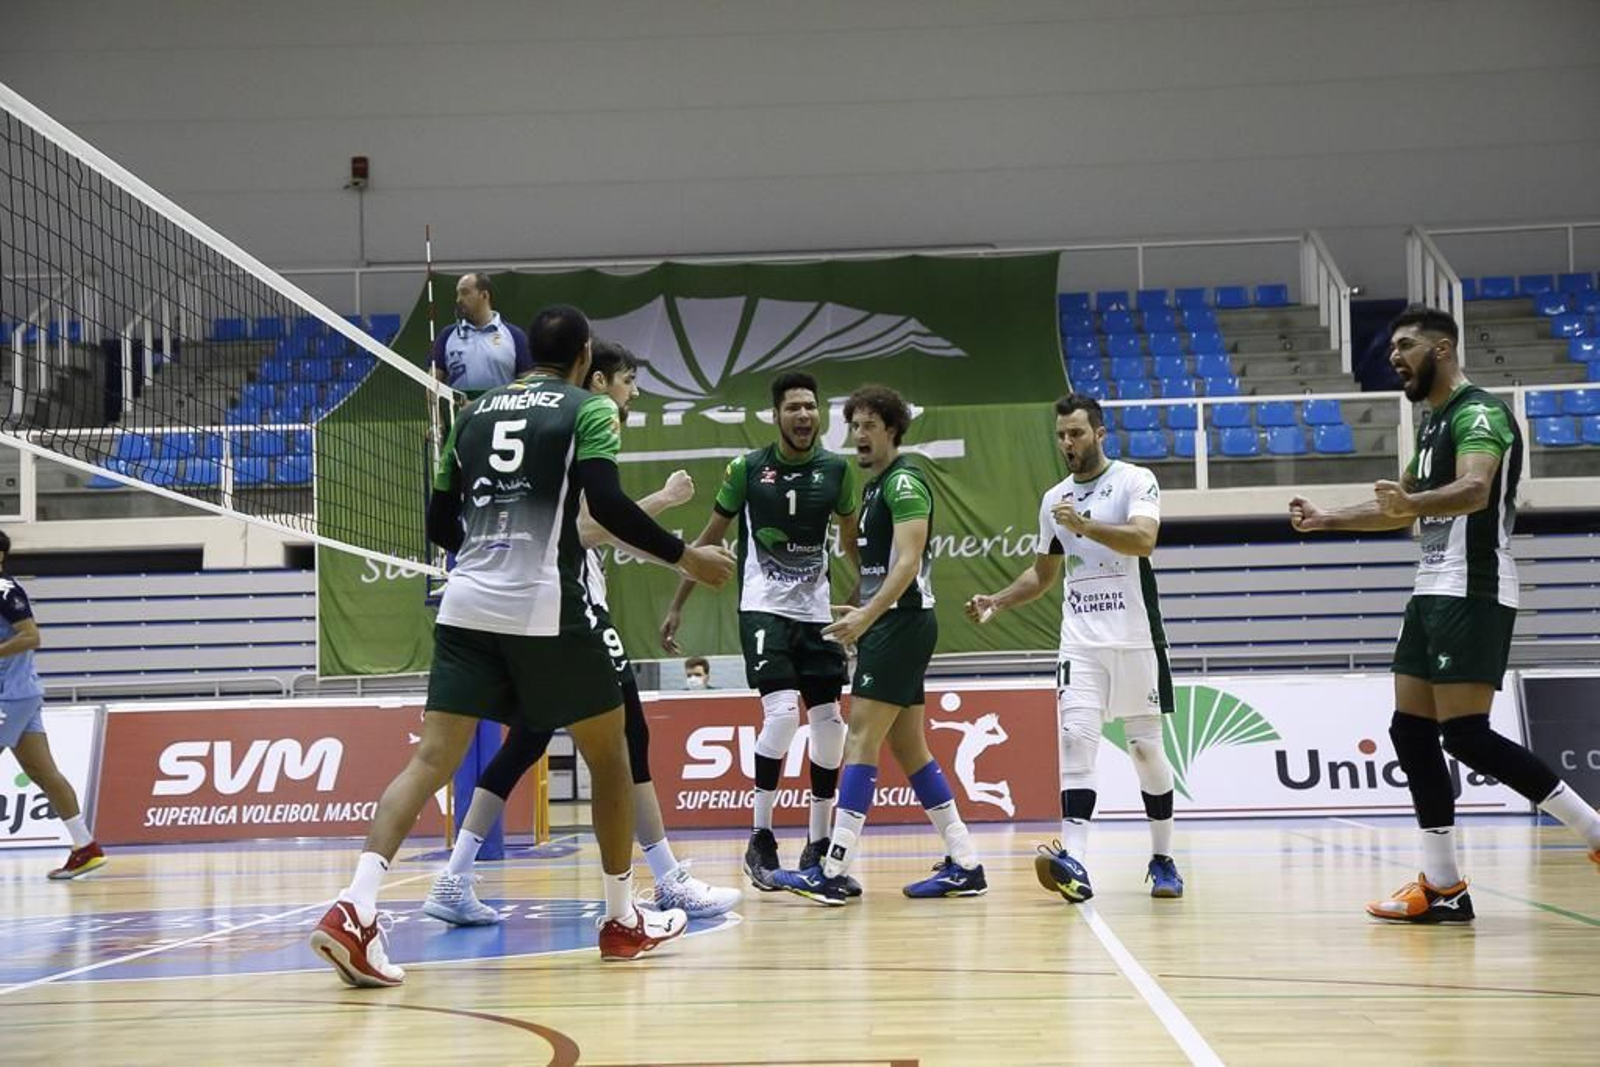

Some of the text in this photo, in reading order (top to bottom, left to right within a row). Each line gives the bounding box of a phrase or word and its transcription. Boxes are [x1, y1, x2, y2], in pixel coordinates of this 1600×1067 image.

[489, 419, 527, 473] 5
[1418, 447, 1433, 480] 10
[785, 490, 796, 516] 1
[930, 526, 1039, 557] mería
[1083, 593, 1110, 602] COSTA
[603, 628, 624, 656] 9
[755, 629, 765, 655] 1
[152, 737, 343, 796] SVM
[676, 790, 755, 809] SUPERLIG
[144, 802, 378, 827] SUPERLIGA VOLEIBOL MASC
